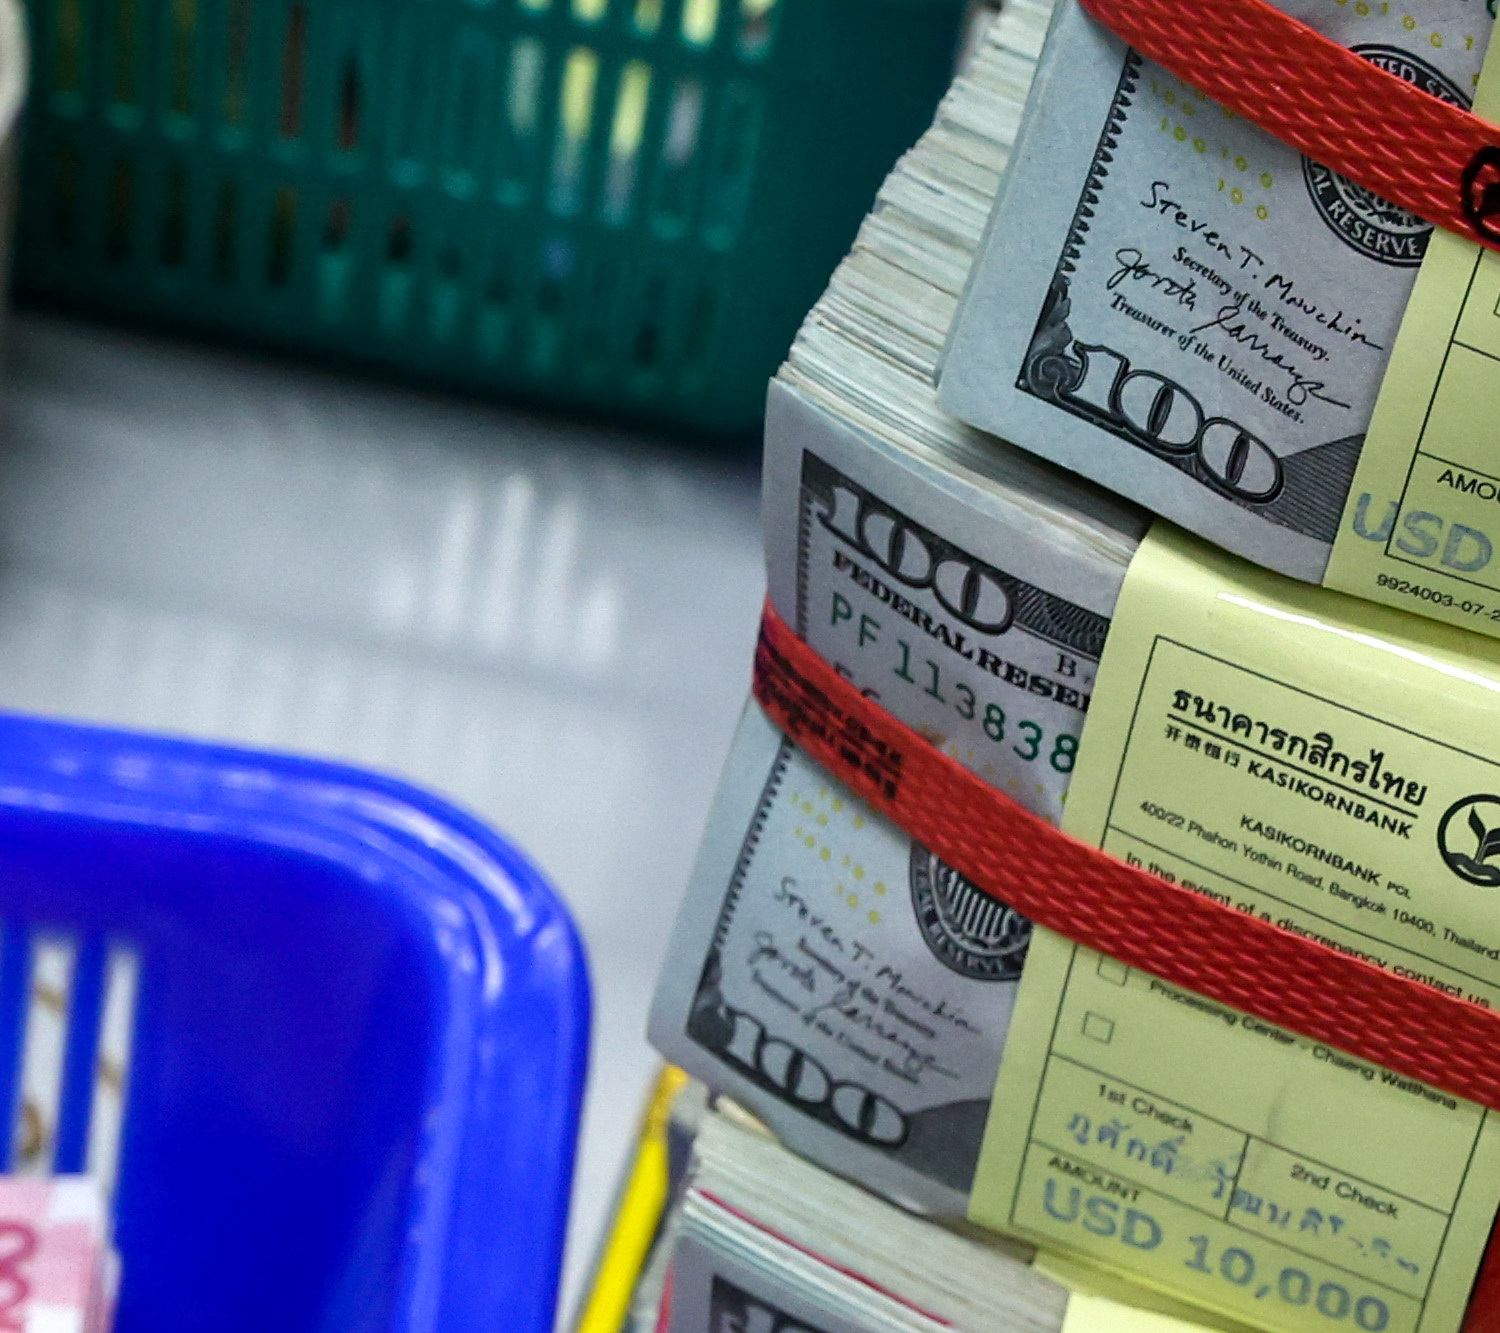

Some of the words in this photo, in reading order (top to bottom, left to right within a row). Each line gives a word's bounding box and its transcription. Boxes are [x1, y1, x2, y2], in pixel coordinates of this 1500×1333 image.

[1327, 200, 1421, 256] RESERVE
[1110, 293, 1178, 338] Treasurer
[1178, 332, 1194, 350] of
[1193, 341, 1215, 362] the
[1217, 354, 1262, 395] United
[1172, 246, 1232, 296] Secretary
[1233, 288, 1249, 307] of
[1247, 300, 1268, 320] the
[1270, 312, 1331, 362] Treasury.
[1071, 340, 1285, 504] 100
[816, 485, 1015, 636] 100
[1351, 493, 1494, 573] USD
[833, 550, 973, 660] FEDERAL
[830, 591, 1079, 773] PF113838
[1170, 687, 1429, 807] ธนาคารกสิกรไทย
[1247, 760, 1413, 839] KASIKORNBANK
[1140, 800, 1185, 829] 400/22
[1187, 820, 1238, 851] Phahon
[1329, 882, 1387, 917] Bangkok
[1239, 814, 1380, 887] KASIKORNBANK
[1386, 880, 1411, 899] PCL
[716, 1003, 912, 1152] 100
[1098, 1084, 1128, 1108] 1st
[1132, 1097, 1194, 1133] Check
[1049, 1157, 1141, 1202] AMOUNT
[1290, 1164, 1331, 1191] 2nd
[1334, 1181, 1399, 1219] Check
[1043, 1178, 1164, 1251] USD
[1184, 1234, 1390, 1333] 10,000
